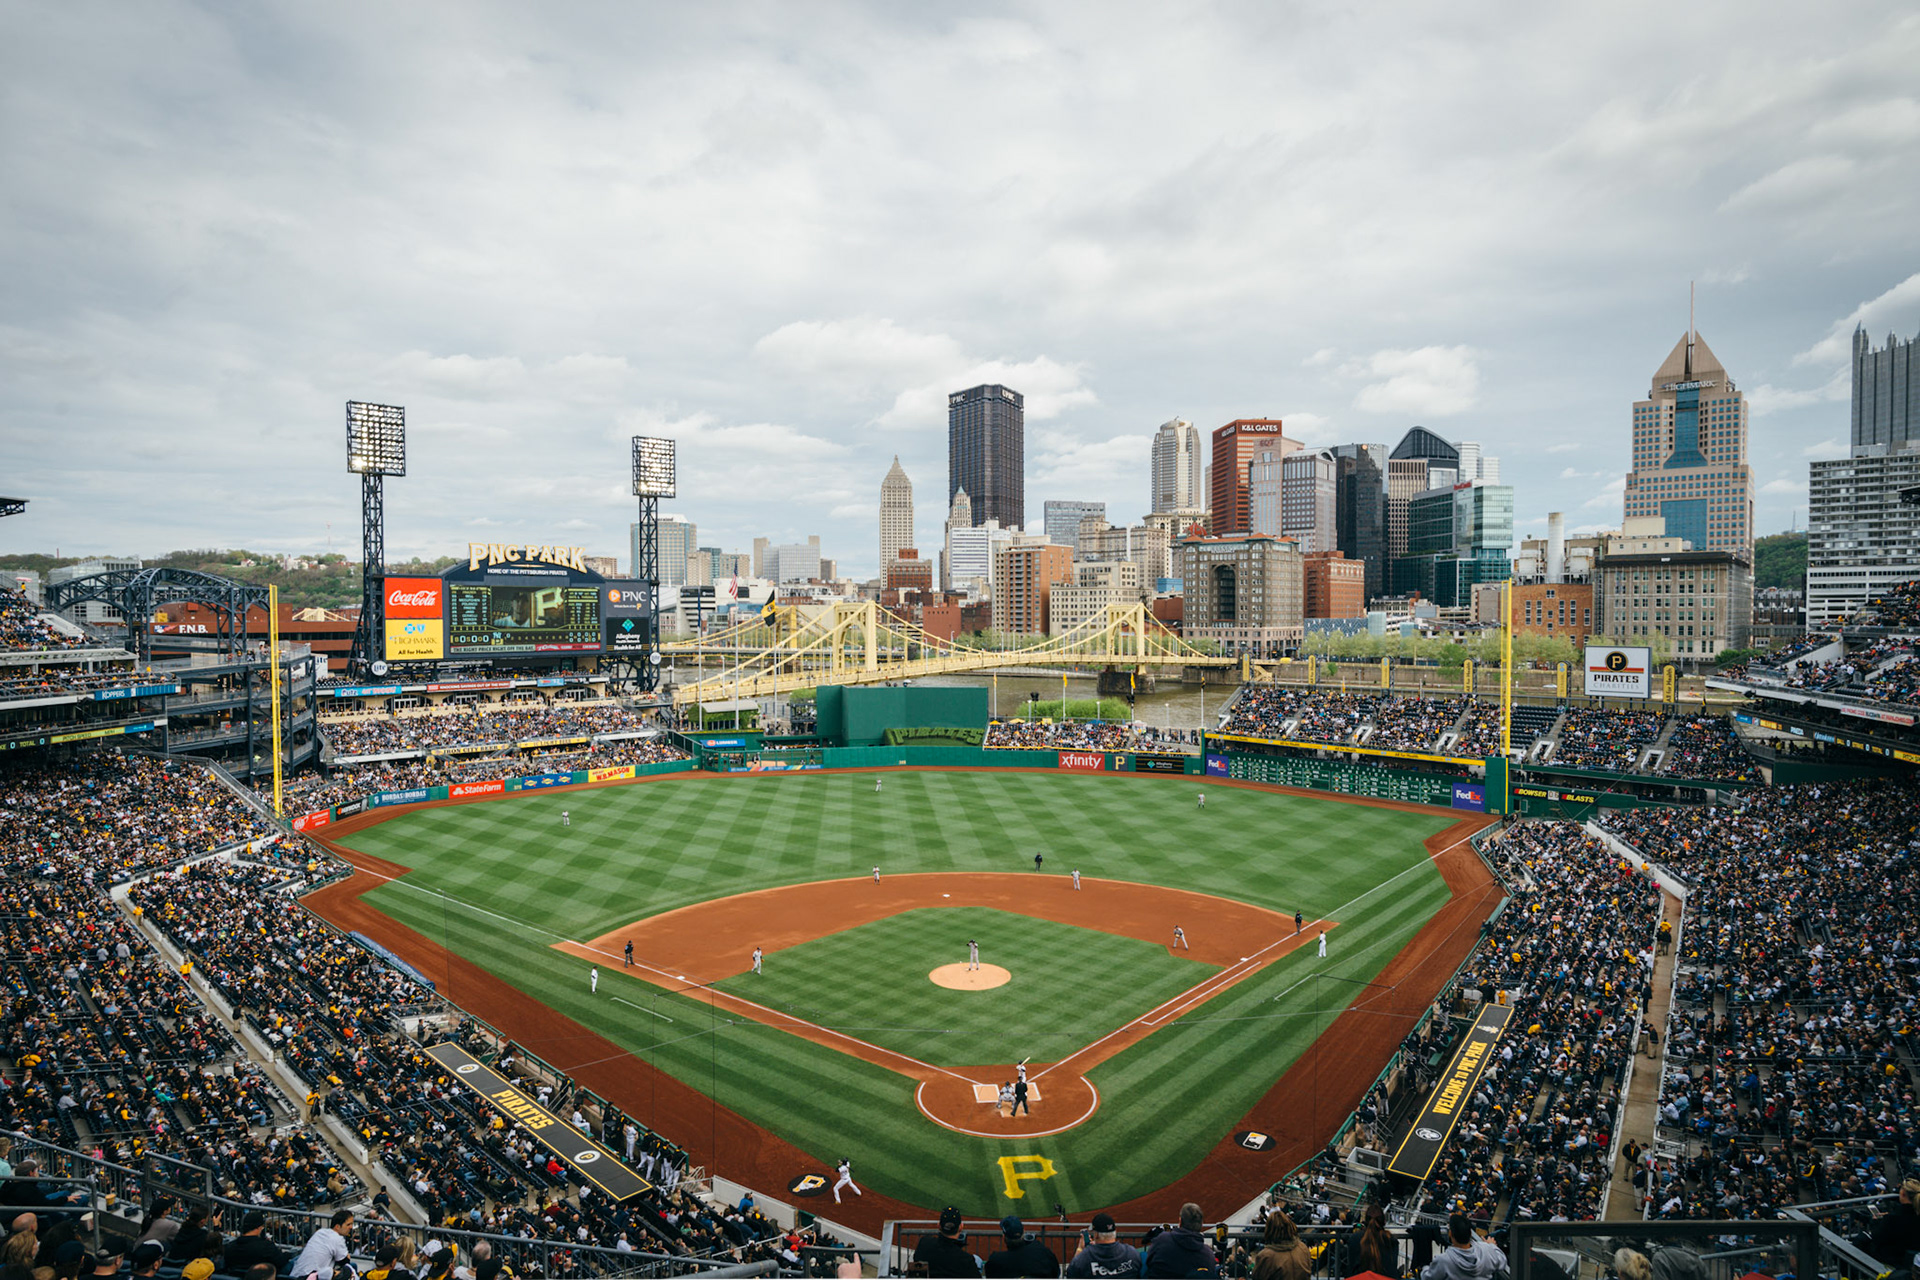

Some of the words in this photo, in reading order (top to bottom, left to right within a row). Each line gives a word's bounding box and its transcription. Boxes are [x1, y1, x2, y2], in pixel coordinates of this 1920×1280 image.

[1241, 424, 1255, 432] K&L
[1255, 424, 1278, 432] GATES
[469, 542, 521, 571] PNC
[525, 544, 588, 573] PARK
[388, 590, 438, 606] Coca-Cola
[622, 591, 647, 602] PNC
[178, 624, 208, 634] F.N.B.
[393, 637, 437, 645] HIGHMARK
[1612, 655, 1622, 668] P
[1594, 674, 1639, 683] PIRATES
[1593, 682, 1640, 690] CHARITIES
[102, 690, 125, 699] KOPPERS
[893, 727, 985, 744] PIRATES
[19, 740, 36, 748] TOTAL
[1062, 754, 1101, 769] xfinity
[1115, 756, 1125, 770] P
[1208, 759, 1226, 769] FedEx
[608, 766, 630, 777] MASON
[381, 792, 402, 801] BORDAS
[405, 790, 427, 799] BORDAS
[464, 783, 502, 795] StateFarm
[1456, 789, 1482, 802] FedEx
[1518, 788, 1547, 798] BOWSER
[1565, 794, 1594, 804] BLASTS
[1465, 1041, 1488, 1060] PARK
[1457, 1056, 1478, 1073] PNC
[1432, 1078, 1467, 1115] WELCOME
[491, 1088, 556, 1131] PIRATES
[792, 1174, 826, 1193] P
[997, 1155, 1058, 1199] P
